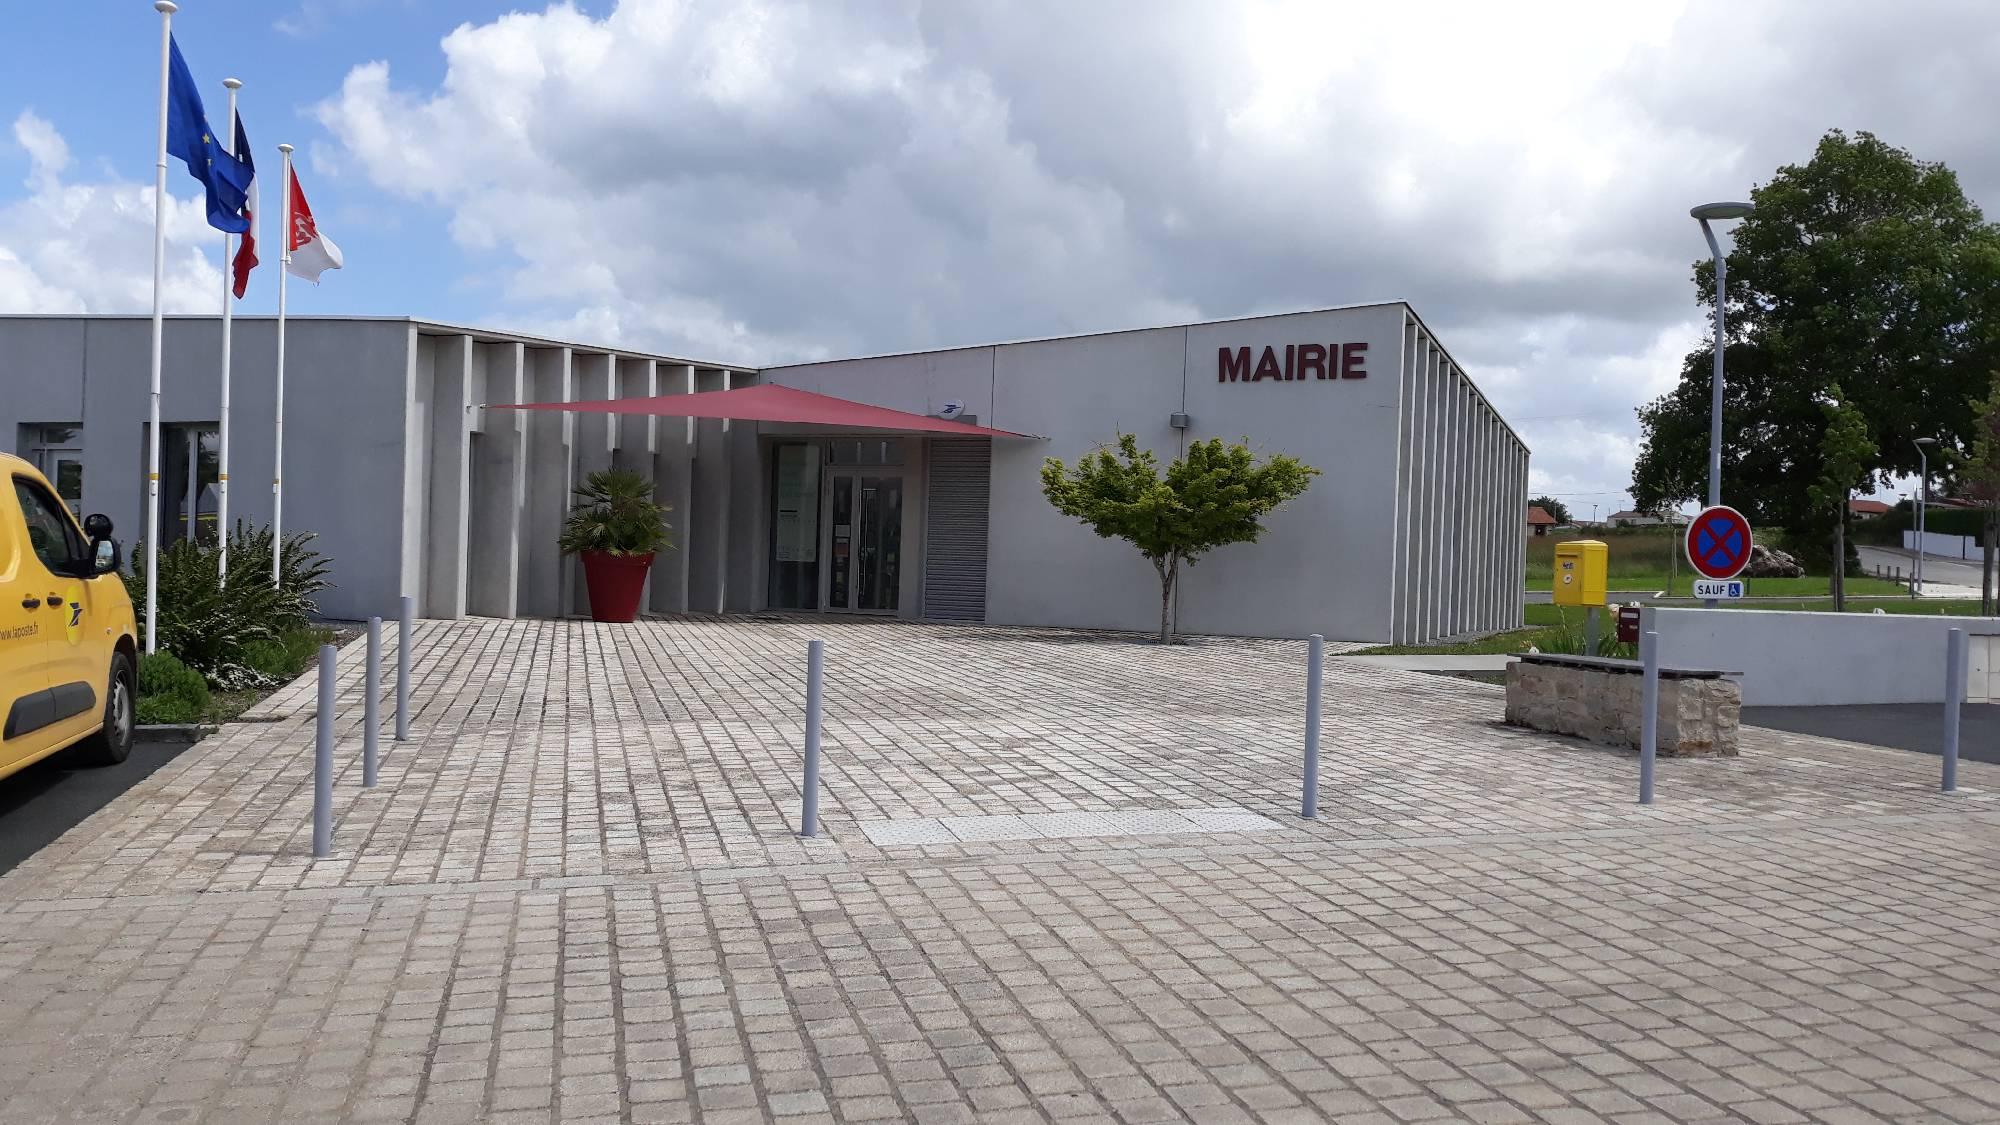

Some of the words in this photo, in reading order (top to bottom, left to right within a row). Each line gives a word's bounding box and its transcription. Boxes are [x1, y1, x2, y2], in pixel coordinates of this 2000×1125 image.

[1218, 343, 1368, 382] MAIRIE
[1697, 584, 1726, 595] SAUF
[0, 621, 39, 641] ww.laposte.fr
